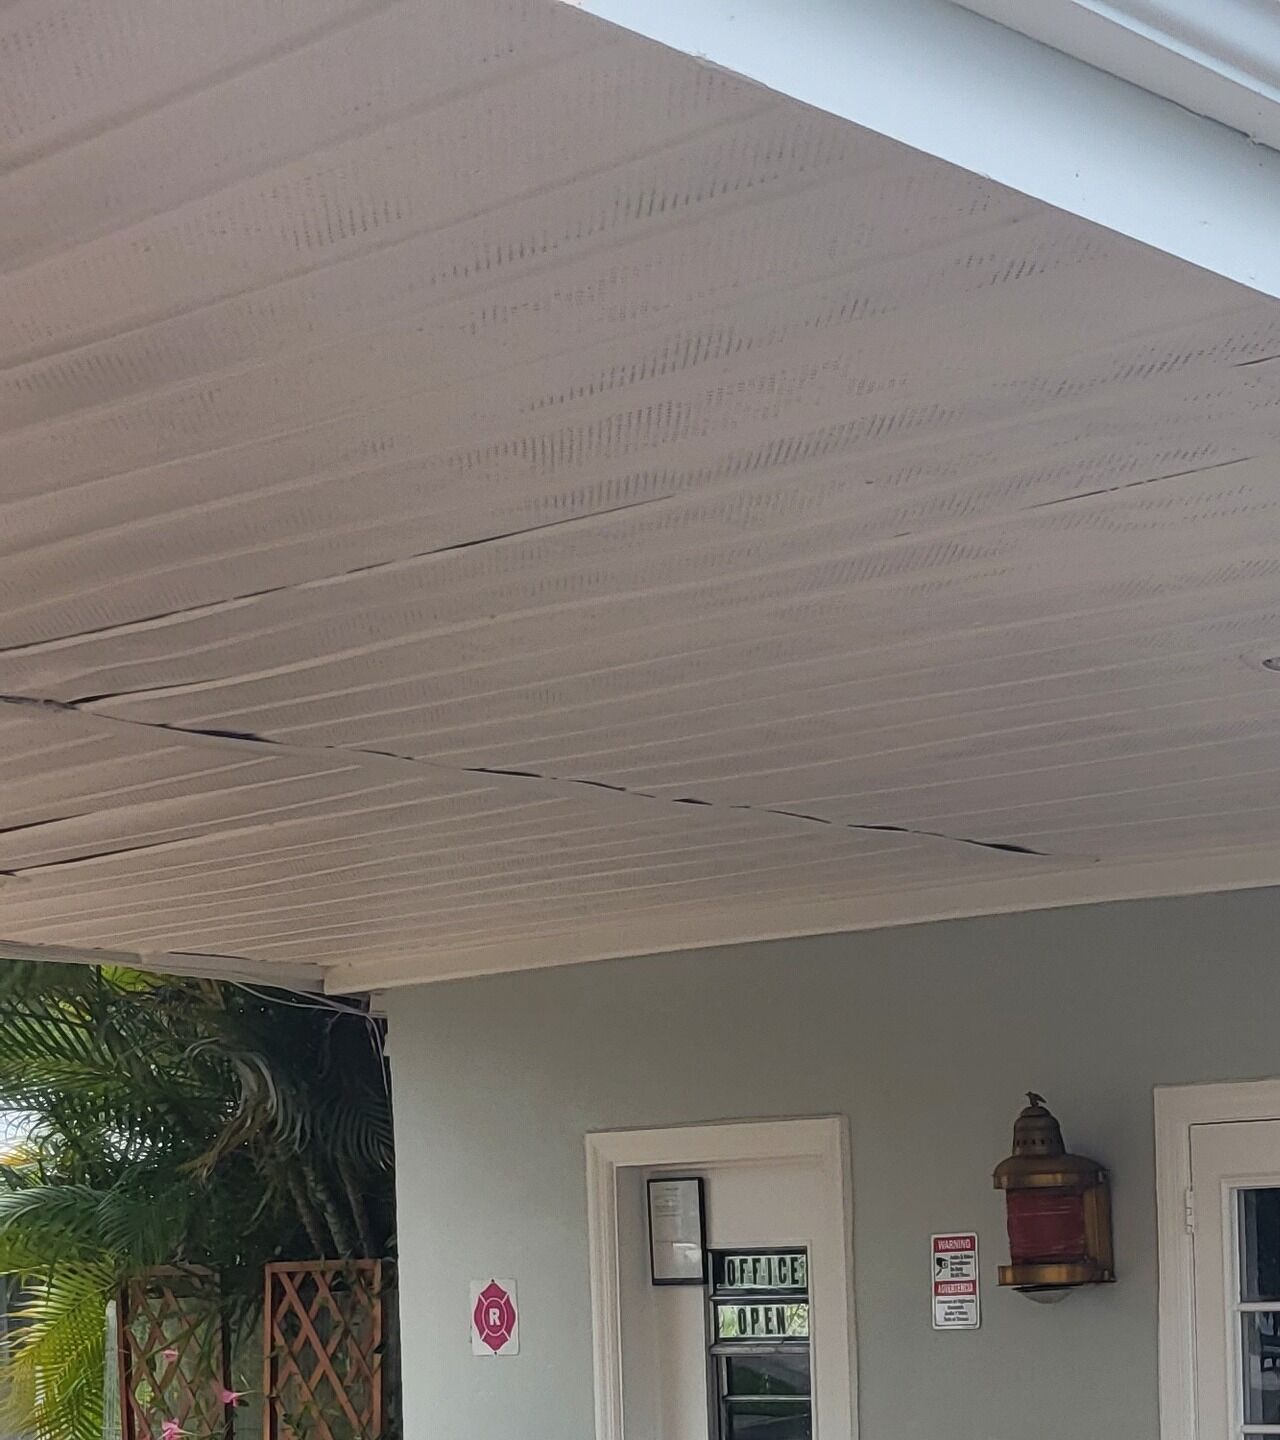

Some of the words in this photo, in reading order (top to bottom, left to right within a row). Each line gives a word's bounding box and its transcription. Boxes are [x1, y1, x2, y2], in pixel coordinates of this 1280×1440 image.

[938, 1239, 971, 1250] WARNING
[726, 1256, 800, 1287] OFFICE
[489, 1308, 501, 1326] R
[737, 1306, 786, 1335] OPEN
